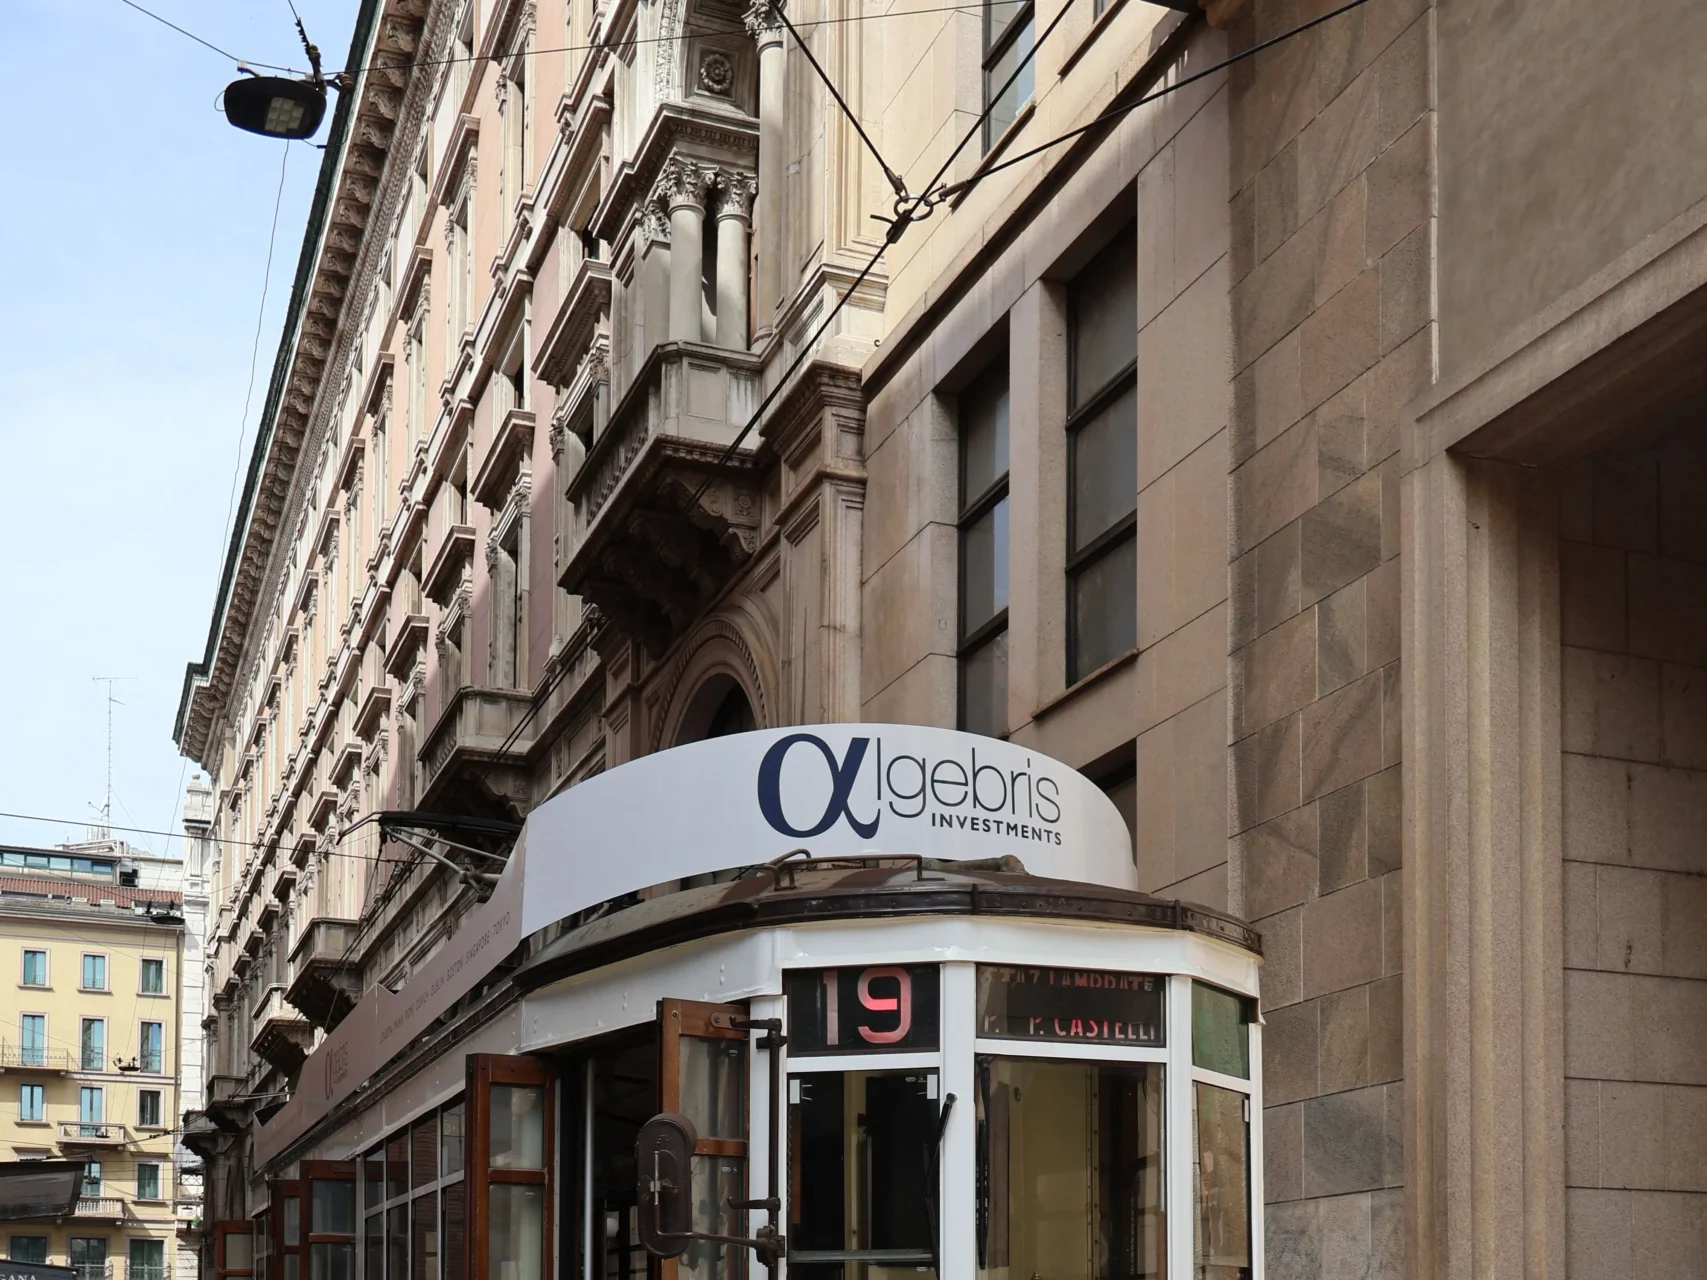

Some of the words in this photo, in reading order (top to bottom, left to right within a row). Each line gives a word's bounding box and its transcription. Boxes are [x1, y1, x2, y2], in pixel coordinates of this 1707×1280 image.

[931, 812, 1062, 846] INVESTMENTS
[493, 911, 510, 936] TOKYO
[822, 967, 912, 1046] 19
